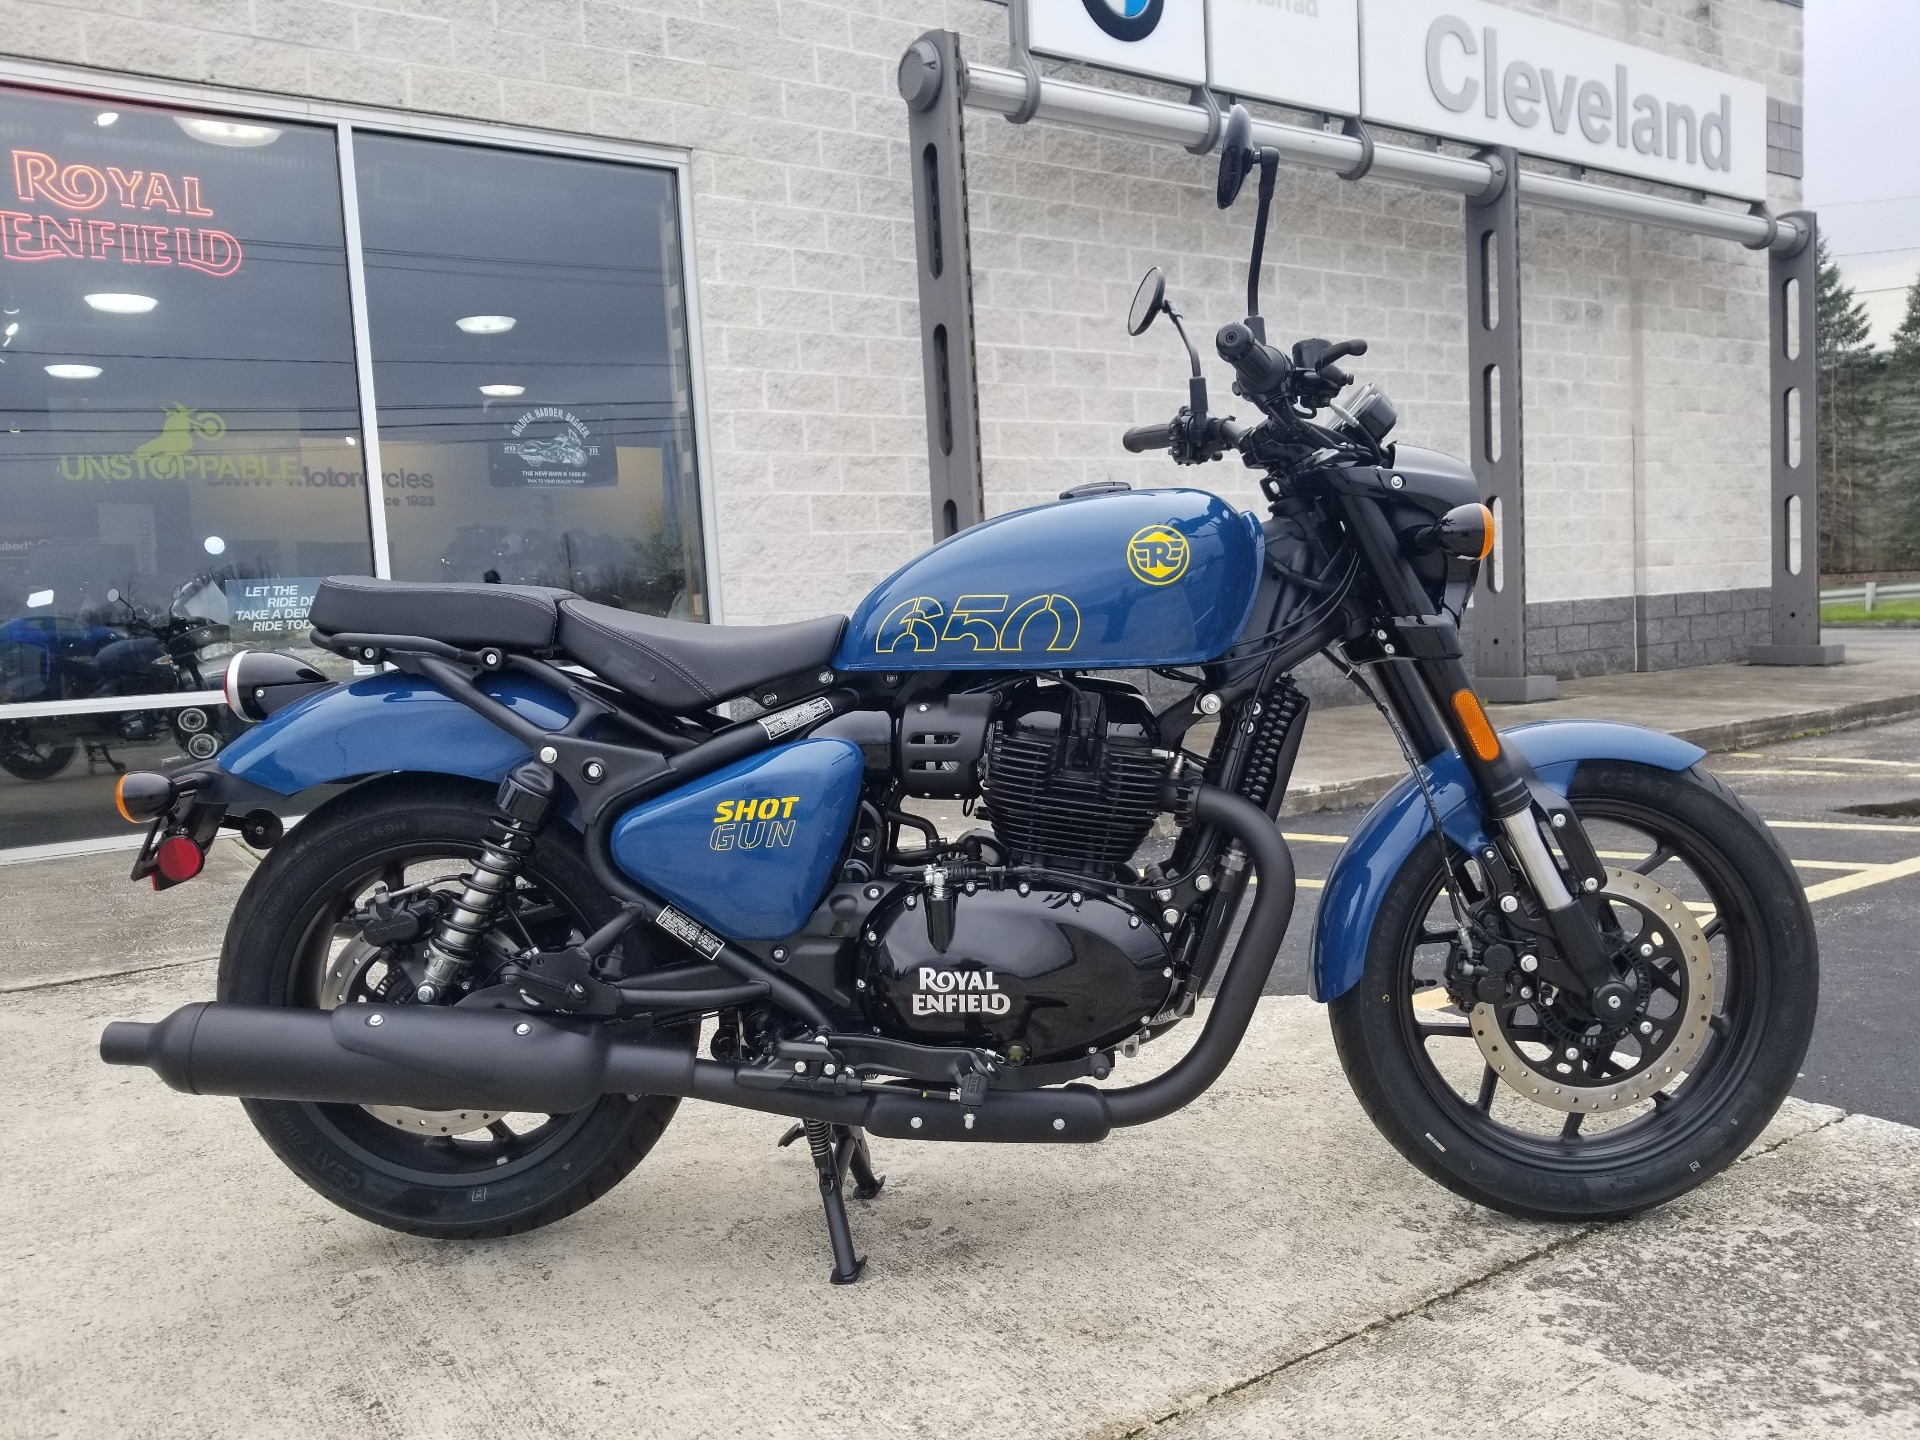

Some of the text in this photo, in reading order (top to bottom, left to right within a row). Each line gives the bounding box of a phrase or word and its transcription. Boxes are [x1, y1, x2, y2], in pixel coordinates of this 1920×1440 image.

[1425, 14, 1731, 172] Cleveland
[11, 150, 214, 218] ROYAL
[0, 210, 242, 277] ENFIELD
[59, 453, 300, 481] UNSTOPPABLE
[245, 585, 298, 597] LET THE
[267, 596, 297, 607] RIDE
[236, 607, 310, 620] TAKE A DEM
[252, 620, 282, 632] RIDE
[875, 594, 1081, 653] 650
[713, 796, 799, 823] SHOT
[709, 820, 796, 851] GUN
[919, 967, 999, 992] ROYAL
[912, 993, 1011, 1016] ENFIELD
